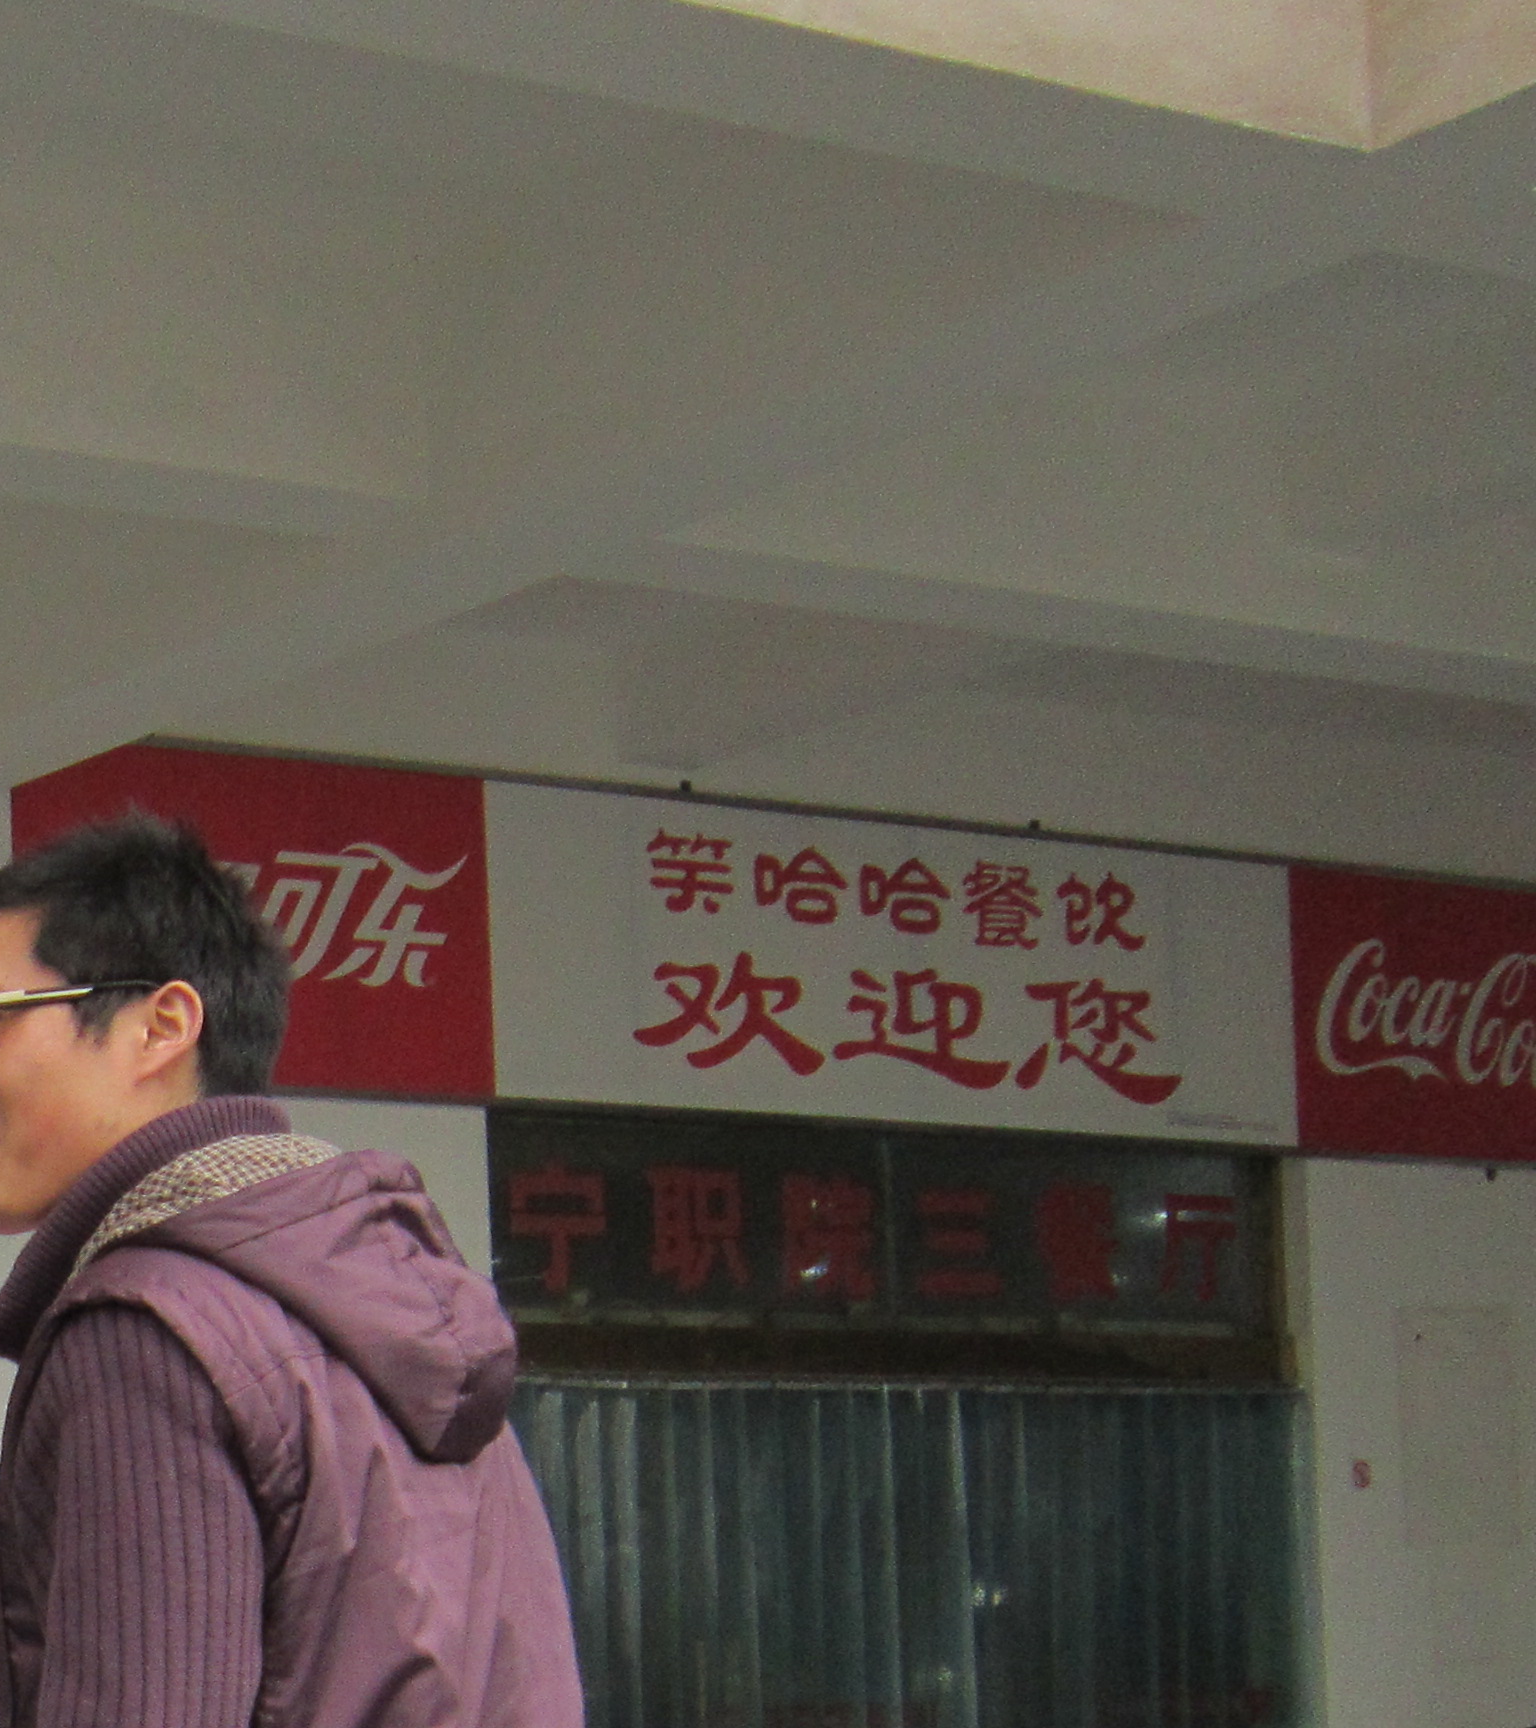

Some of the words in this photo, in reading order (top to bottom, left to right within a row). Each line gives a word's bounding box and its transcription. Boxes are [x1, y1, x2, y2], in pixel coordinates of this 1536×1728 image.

[228, 841, 469, 988] 可乐
[646, 830, 1146, 951] 笑哈哈餐饮
[633, 952, 1182, 1105] 欢迎您
